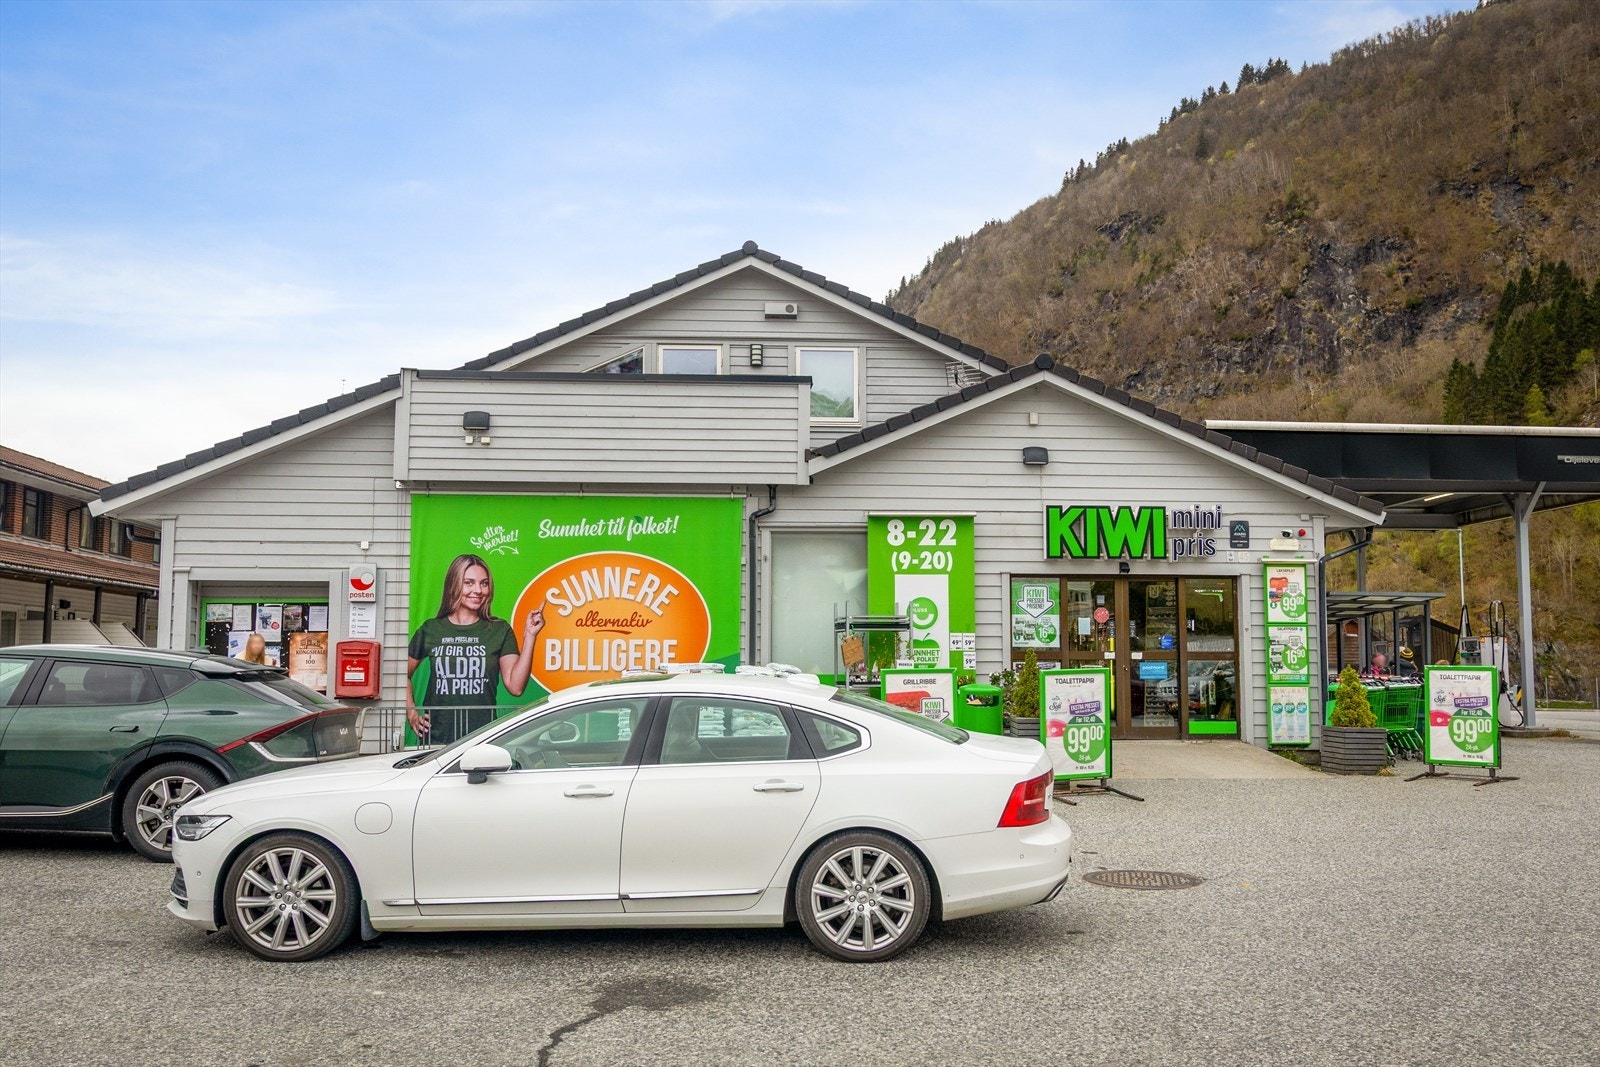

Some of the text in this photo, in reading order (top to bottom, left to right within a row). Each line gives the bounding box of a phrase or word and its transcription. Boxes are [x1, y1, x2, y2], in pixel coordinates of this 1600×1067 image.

[1171, 504, 1223, 530] mini
[470, 525, 505, 549] Se etter
[538, 515, 680, 542] Sunnhet til folket!
[886, 519, 957, 547] 8-22
[1046, 505, 1167, 559] KIWI
[483, 529, 519, 551] merket!
[1171, 531, 1217, 563] pris
[891, 551, 953, 572] (9-20)
[349, 591, 375, 599] posten
[545, 566, 680, 617] SUNNERE
[1026, 589, 1045, 598] KIWI
[575, 609, 653, 629] alternativ
[445, 645, 464, 656] GIR
[466, 645, 486, 656] OSS
[545, 639, 678, 672] BILLIGERE
[435, 656, 487, 678] ALDRI
[435, 675, 449, 695] PÅ
[903, 678, 937, 686] GRILLRIBBE
[1055, 677, 1095, 685] TOALETTPAPIR
[924, 701, 941, 709] KIWI
